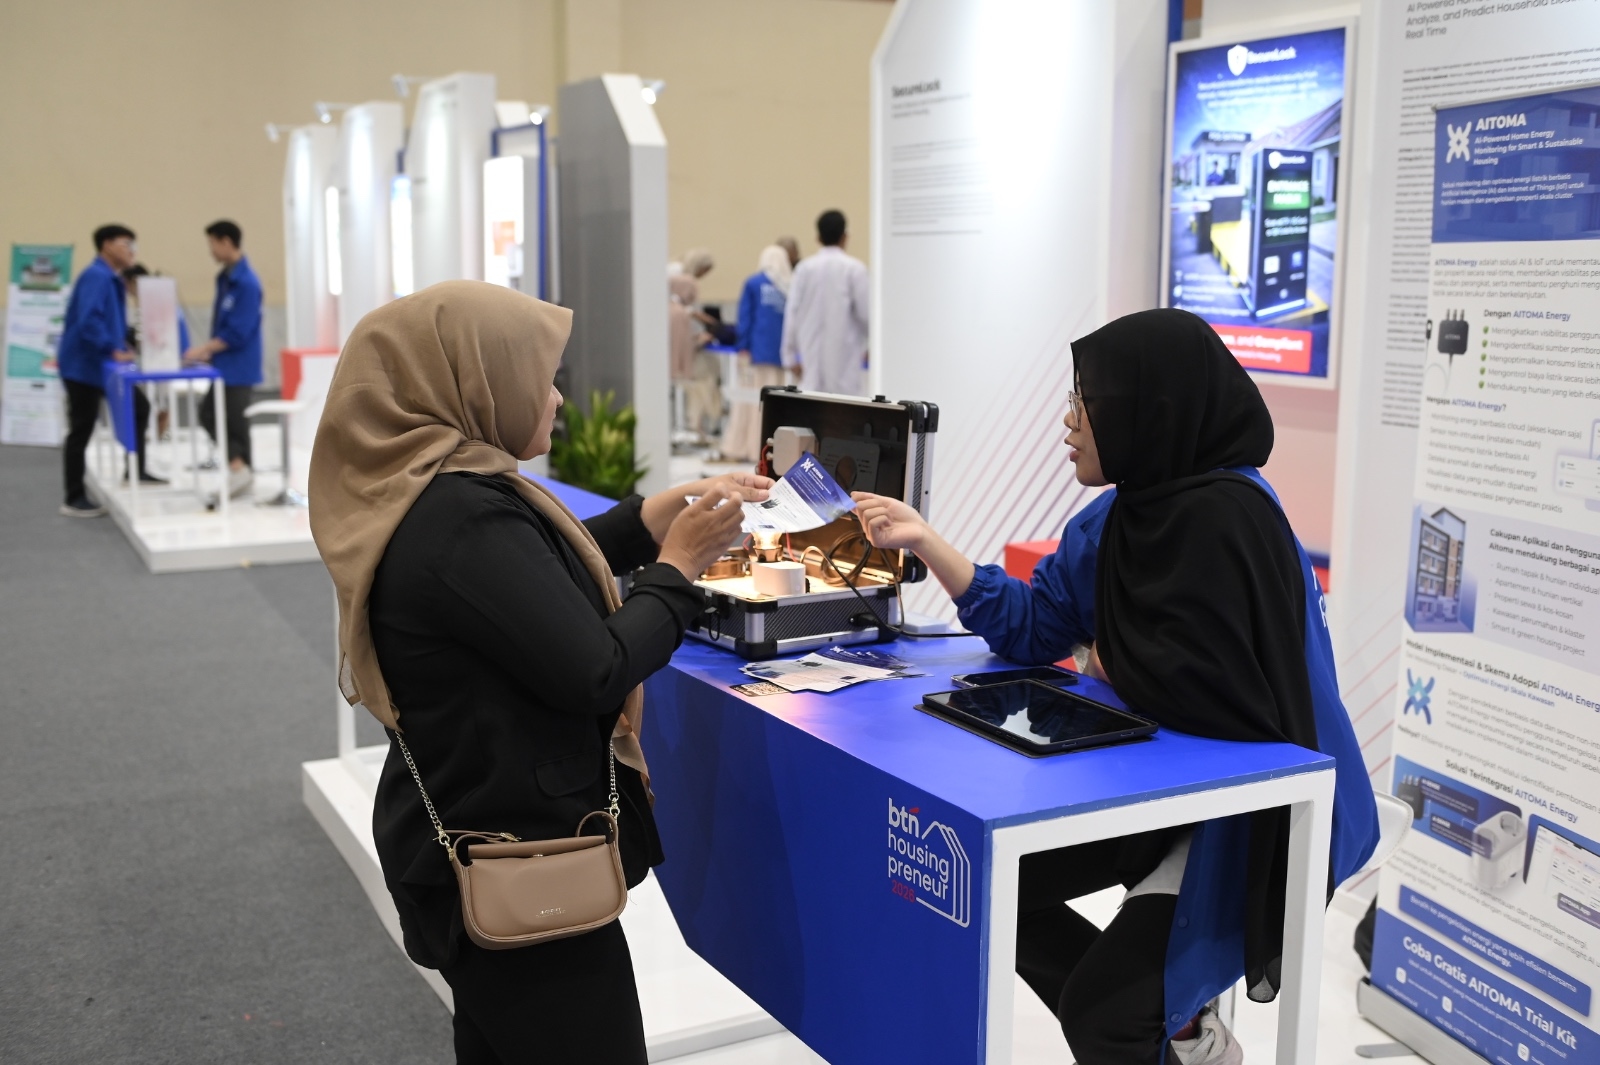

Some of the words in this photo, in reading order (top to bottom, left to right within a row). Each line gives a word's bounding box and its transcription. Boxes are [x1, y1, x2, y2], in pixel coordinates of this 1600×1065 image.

[1417, 0, 1454, 11] Powered
[1443, 10, 1460, 20] and
[1463, 5, 1495, 17] Predict
[1497, 0, 1548, 13] Household
[1406, 29, 1424, 39] Real
[1426, 27, 1447, 36] Time
[1476, 113, 1527, 131] AITOMA
[1531, 130, 1555, 138] Energy
[1474, 146, 1507, 154] Monitoring
[1508, 142, 1517, 151] for
[1518, 142, 1538, 150] Smart
[1545, 138, 1584, 148] Sustainable
[1474, 157, 1498, 165] Housing
[1457, 259, 1477, 267] Energy
[1549, 281, 1579, 289] penghuni
[1484, 309, 1511, 319] Dengan
[1513, 311, 1543, 319] AITOMA
[1546, 312, 1571, 321] Energy
[1492, 327, 1539, 336] Meningkatkan
[1540, 329, 1568, 338] visibilitas
[1490, 341, 1544, 351] Mengidentifikasi
[1489, 355, 1545, 365] Mengoptimalkan
[1547, 359, 1576, 367] konsumsi
[1578, 360, 1594, 369] listrik
[1488, 369, 1526, 378] Mengontrol
[1528, 372, 1545, 380] biaya
[1564, 375, 1583, 383] secara
[1488, 382, 1527, 393] Mendukung
[1529, 386, 1551, 394] hunian
[1552, 389, 1567, 398] yang
[1569, 389, 1584, 397] lebih
[1452, 399, 1476, 407] AITOMA
[1478, 401, 1506, 412] Energy?
[1480, 420, 1506, 428] berbasis
[1508, 423, 1525, 431] cloud
[1548, 427, 1566, 436] kapan
[1494, 450, 1521, 460] berbasis
[1471, 461, 1482, 469] dan
[1516, 470, 1537, 479] energi
[1482, 478, 1506, 487] mudah
[1508, 482, 1537, 492] dipahami
[1496, 495, 1540, 508] penghematan
[1542, 503, 1563, 513] praktis
[1490, 528, 1520, 541] Cakupan
[1523, 535, 1550, 548] Aplikasi
[1551, 541, 1564, 550] dan
[1489, 542, 1514, 554] Aitoma
[1516, 549, 1557, 565] mendukung
[1559, 558, 1589, 572] berbagai
[1497, 562, 1520, 574] Rumah
[1521, 568, 1539, 580] tapak
[1539, 572, 1545, 580] &
[1545, 574, 1567, 586] hunian
[1568, 580, 1600, 595] individual
[1495, 578, 1530, 593] Apartemen
[1532, 585, 1537, 594] &
[1538, 588, 1559, 600] hunian
[1560, 594, 1583, 607] vertikal
[1494, 592, 1519, 608] Properti
[1520, 599, 1536, 610] sewa
[1537, 603, 1542, 611] &
[1542, 605, 1573, 620] kos-kosan
[1492, 608, 1520, 621] Kawasan
[1521, 615, 1558, 633] perumahan
[1559, 624, 1564, 633] &
[1564, 625, 1586, 640] klaster
[1491, 622, 1510, 633] Smart
[1510, 626, 1516, 635] &
[1517, 630, 1536, 642] green
[1536, 634, 1562, 650] housing
[1563, 642, 1586, 656] project
[1426, 646, 1475, 667] Implementasi
[1477, 662, 1482, 670] &
[1484, 664, 1510, 679] Skema
[1512, 674, 1540, 688] Adopsi
[1541, 683, 1573, 701] AITOMA
[1491, 680, 1509, 692] Energi
[1511, 686, 1526, 697] Skala
[1528, 693, 1555, 707] Kawasan
[1530, 718, 1543, 728] data
[1557, 728, 1575, 739] sensor
[1523, 728, 1554, 743] pengguna
[1555, 739, 1566, 747] dan
[1567, 745, 1597, 760] pengelola
[1526, 740, 1544, 751] secara
[1546, 747, 1580, 765] menyeluruh
[1535, 755, 1549, 764] skala
[1445, 759, 1467, 774] Solusi
[1469, 768, 1513, 794] Terintegrasi
[1515, 789, 1547, 809] AITOMA
[1550, 803, 1578, 823] Energy
[1556, 790, 1597, 812] pemborosan
[888, 797, 919, 838] btn
[888, 828, 949, 883] housing
[888, 856, 948, 900] preneur
[892, 880, 915, 902] 2026
[1462, 935, 1486, 954] AITOMA
[1553, 938, 1565, 947] dan
[1491, 944, 1507, 955] yang
[1508, 948, 1525, 963] lebih
[1525, 956, 1547, 975] efisien
[1548, 970, 1577, 993] bersama
[1403, 936, 1432, 962] Coba
[1434, 953, 1467, 984] Gratis
[1468, 978, 1522, 1016] AITOMA
[1525, 1006, 1553, 1034] Trial
[1557, 1025, 1577, 1050] Kit
